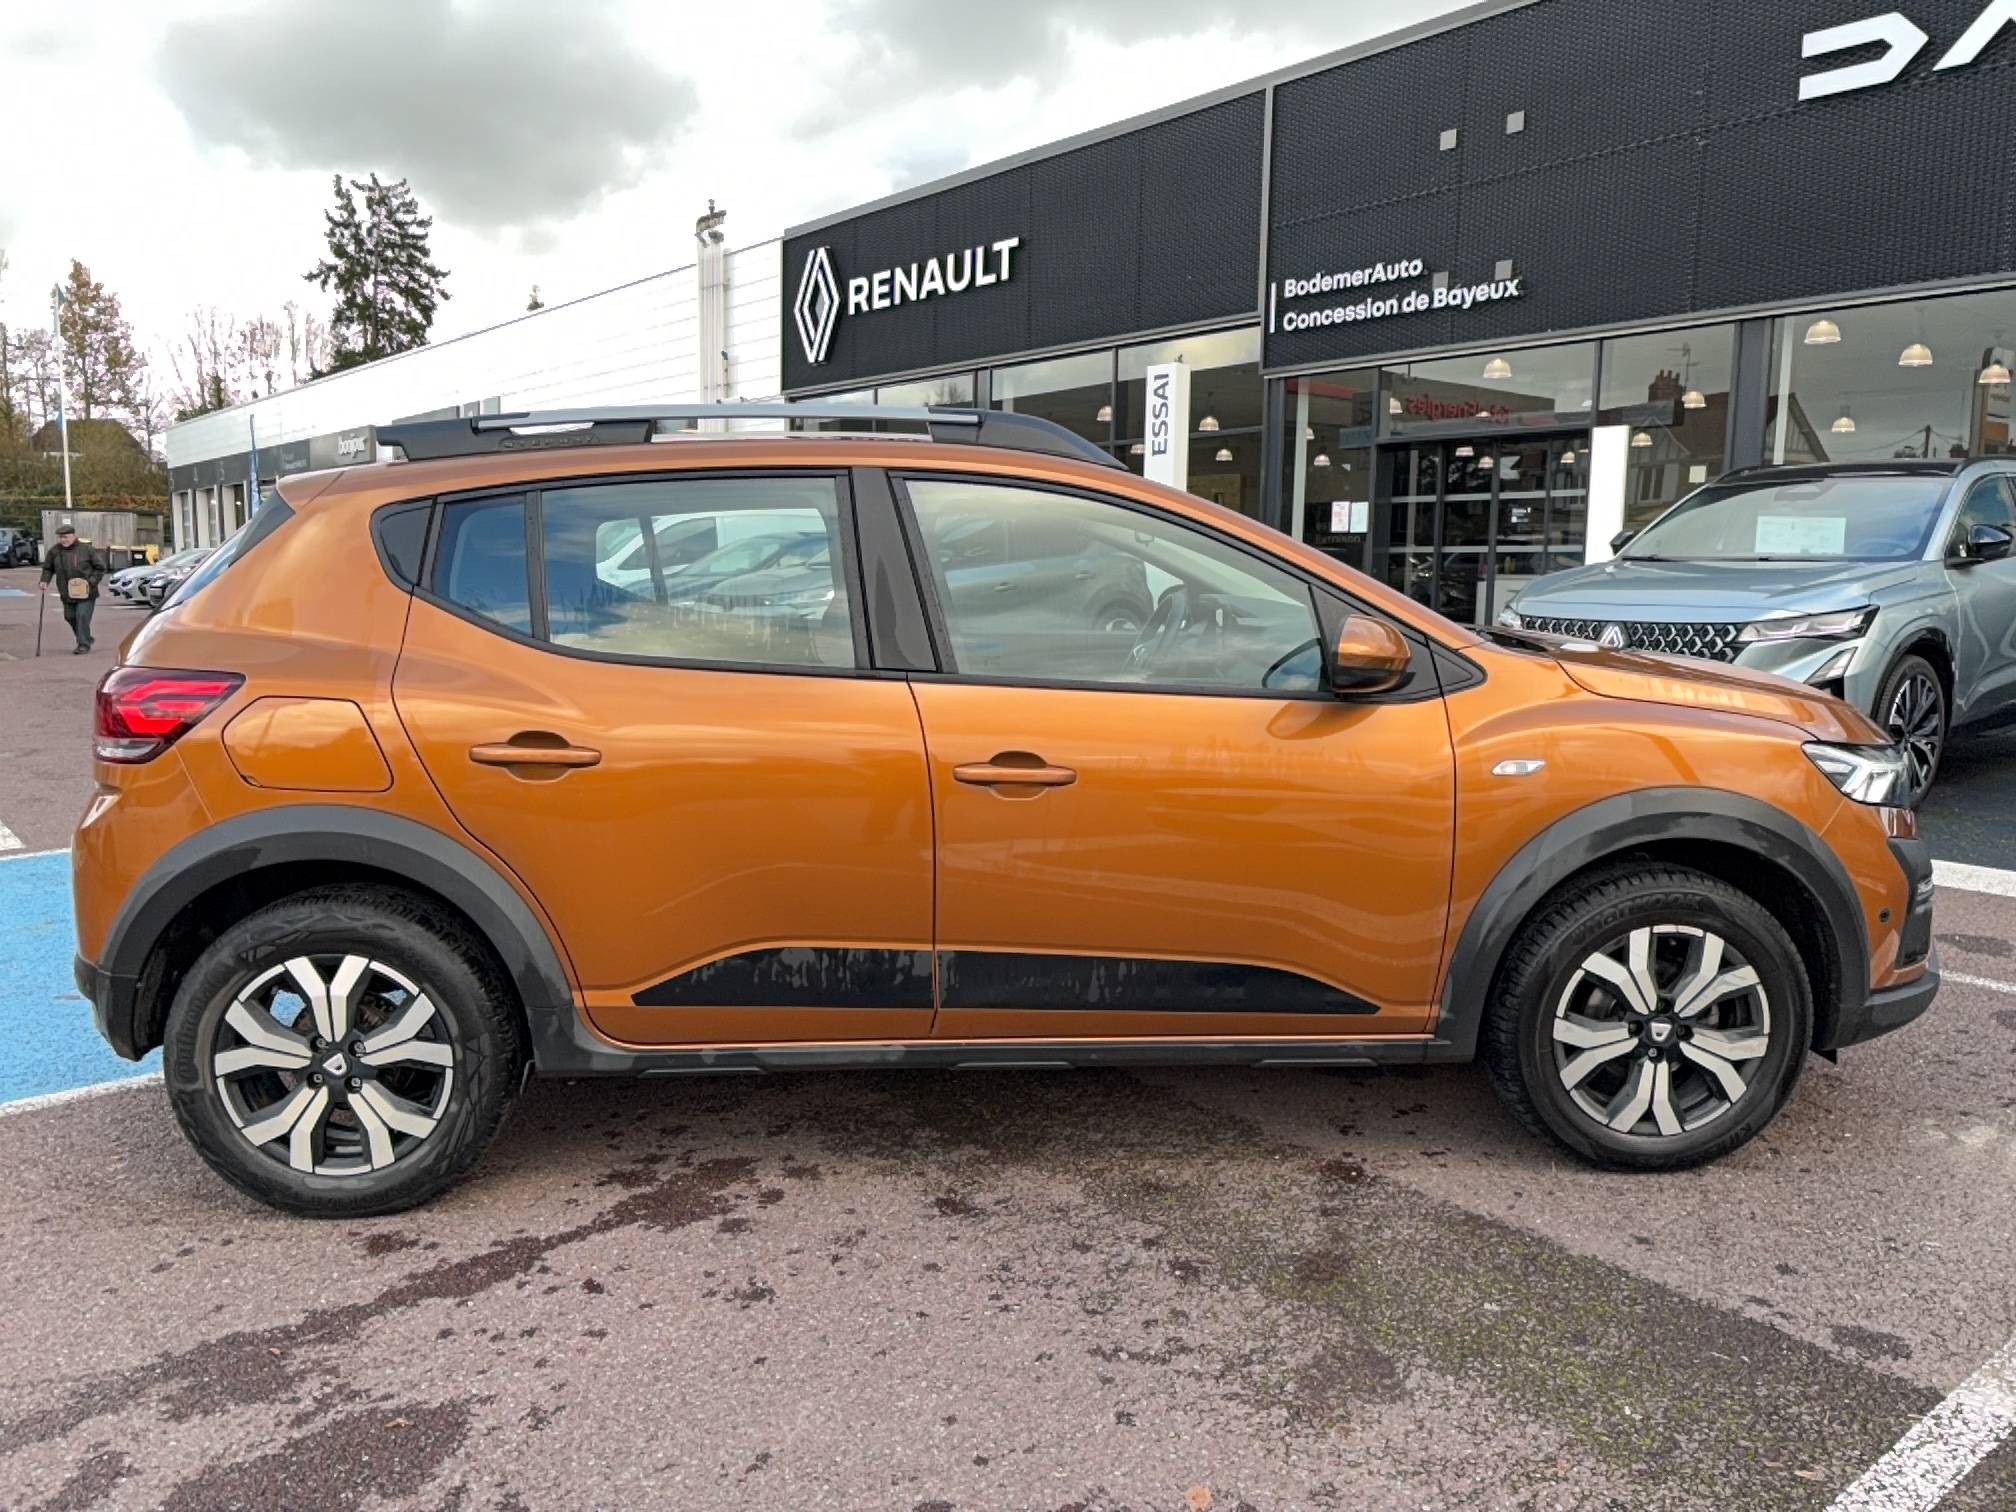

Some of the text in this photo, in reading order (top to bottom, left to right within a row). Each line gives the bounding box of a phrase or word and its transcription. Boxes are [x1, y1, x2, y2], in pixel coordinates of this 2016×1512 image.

[848, 236, 1020, 316] RENAULT
[1283, 257, 1424, 298] BodemerAuto
[1283, 278, 1520, 332] Concession de Bayeux
[1152, 373, 1169, 457] ESSAI
